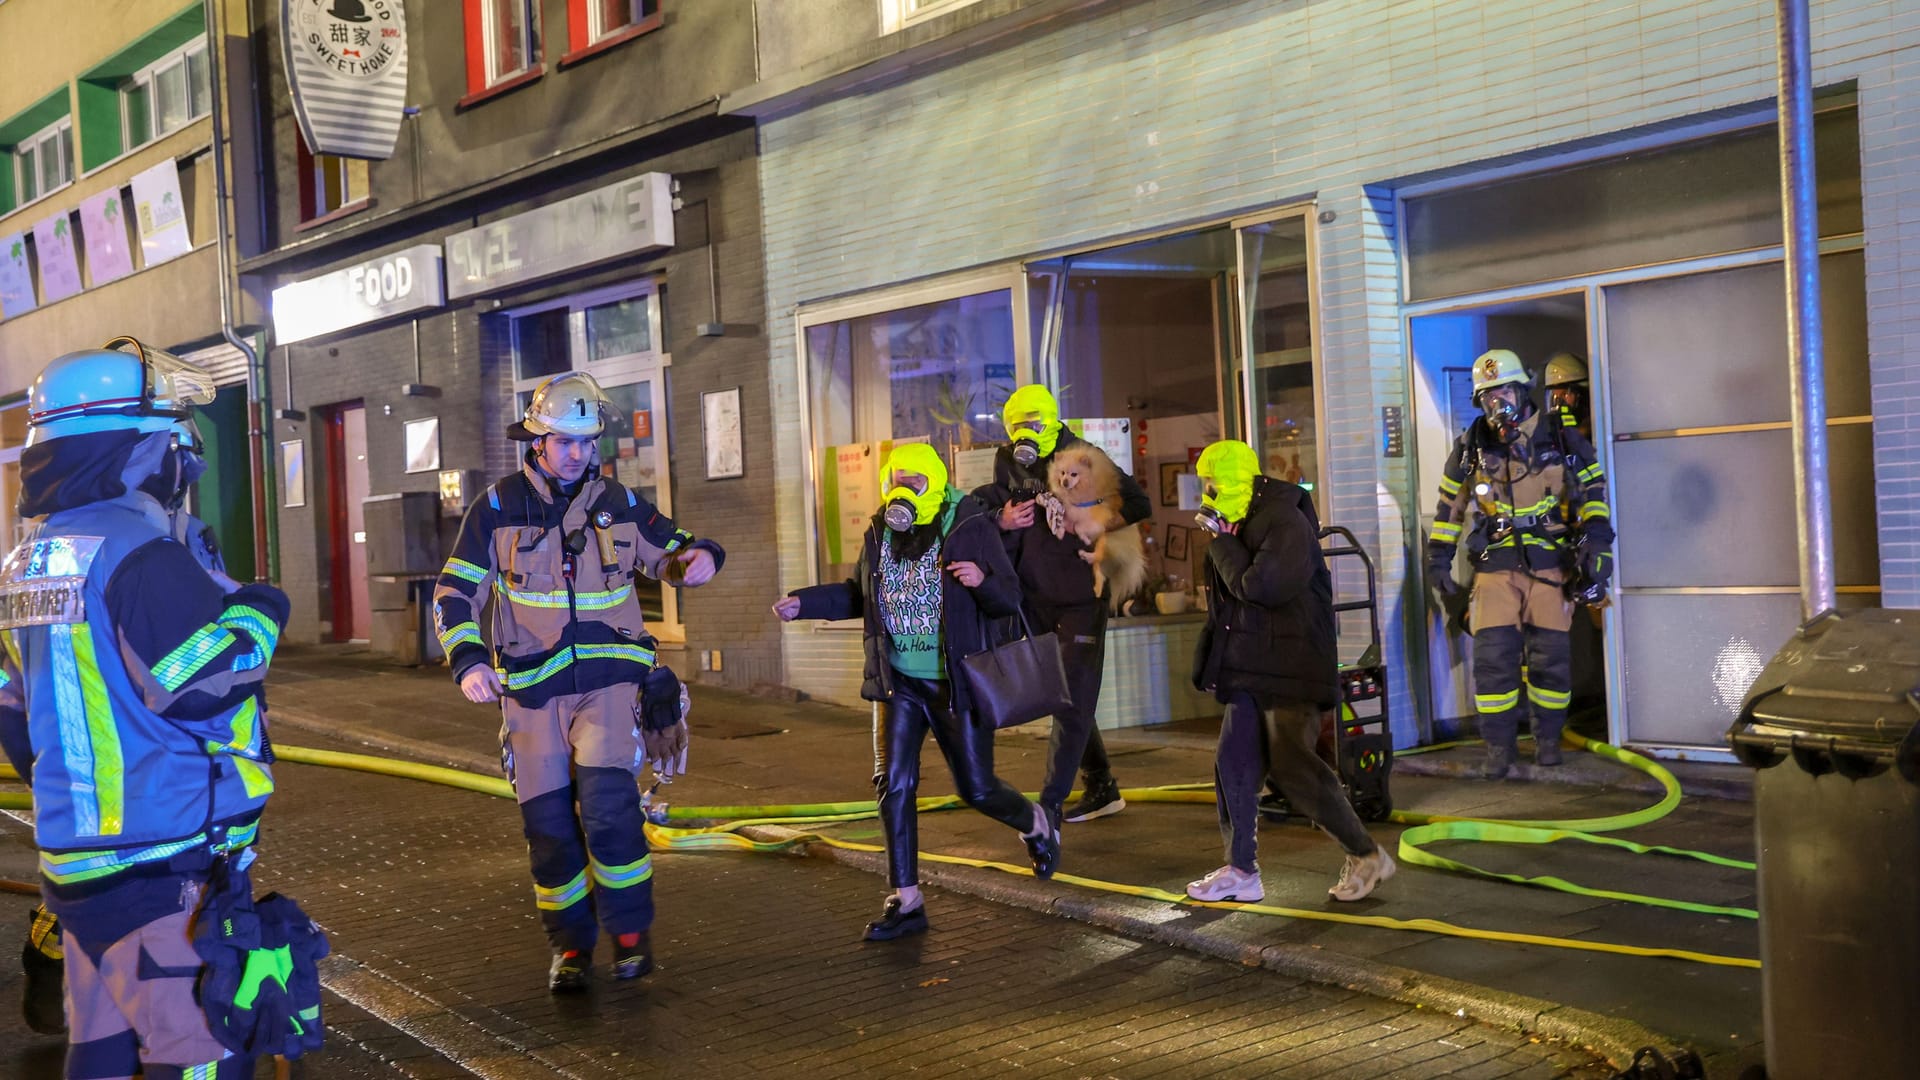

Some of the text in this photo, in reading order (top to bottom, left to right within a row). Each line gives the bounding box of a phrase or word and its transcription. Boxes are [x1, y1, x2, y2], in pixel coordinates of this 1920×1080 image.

[329, 23, 371, 47] 甜家
[308, 32, 393, 75] SWEET HOME
[349, 257, 412, 306] FOOD
[575, 398, 586, 417] 1
